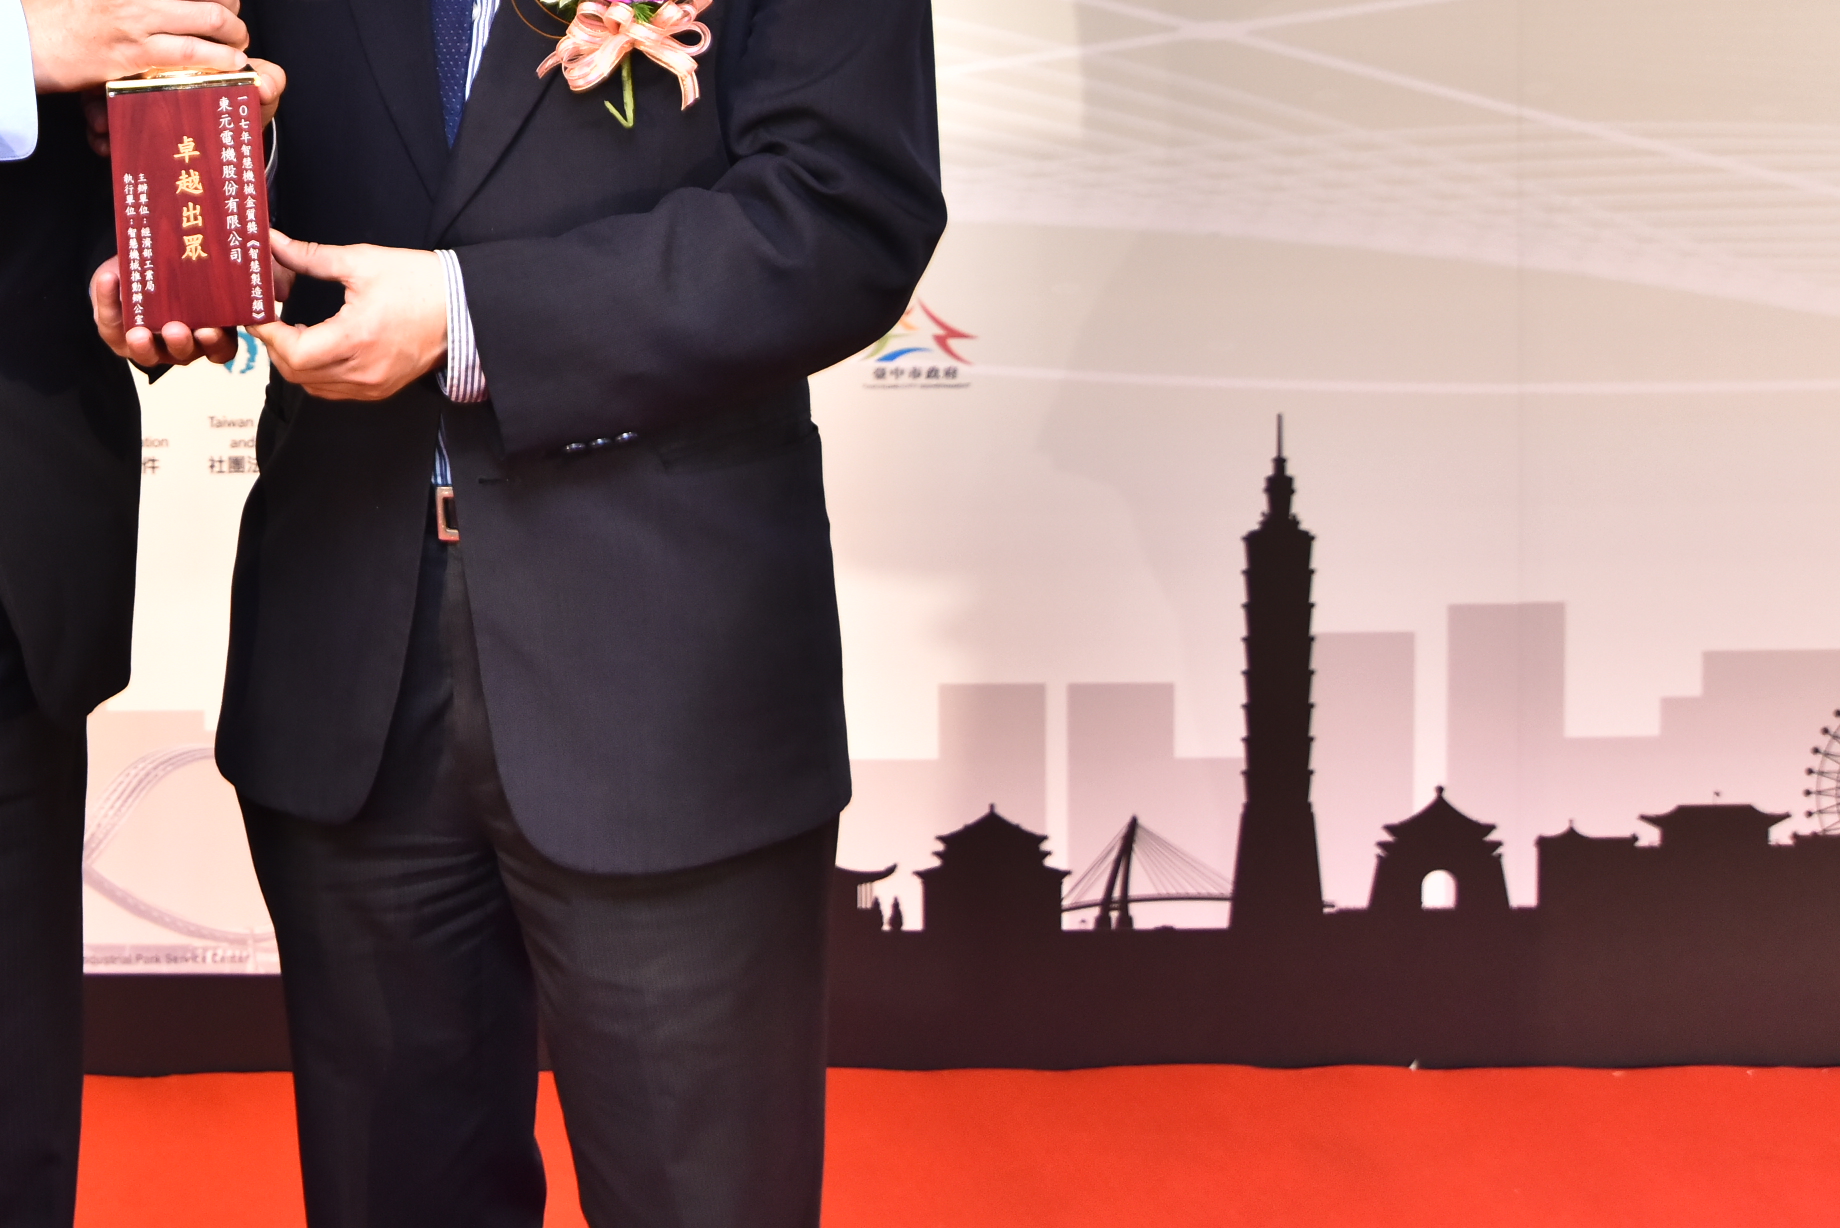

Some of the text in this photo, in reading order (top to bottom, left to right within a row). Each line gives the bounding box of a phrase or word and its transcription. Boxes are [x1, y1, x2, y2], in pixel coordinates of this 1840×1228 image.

[173, 135, 209, 262] 卓越出眾
[217, 96, 243, 264] 東元電機股份有限公司
[208, 415, 255, 428] Taiwan
[230, 435, 256, 449] and
